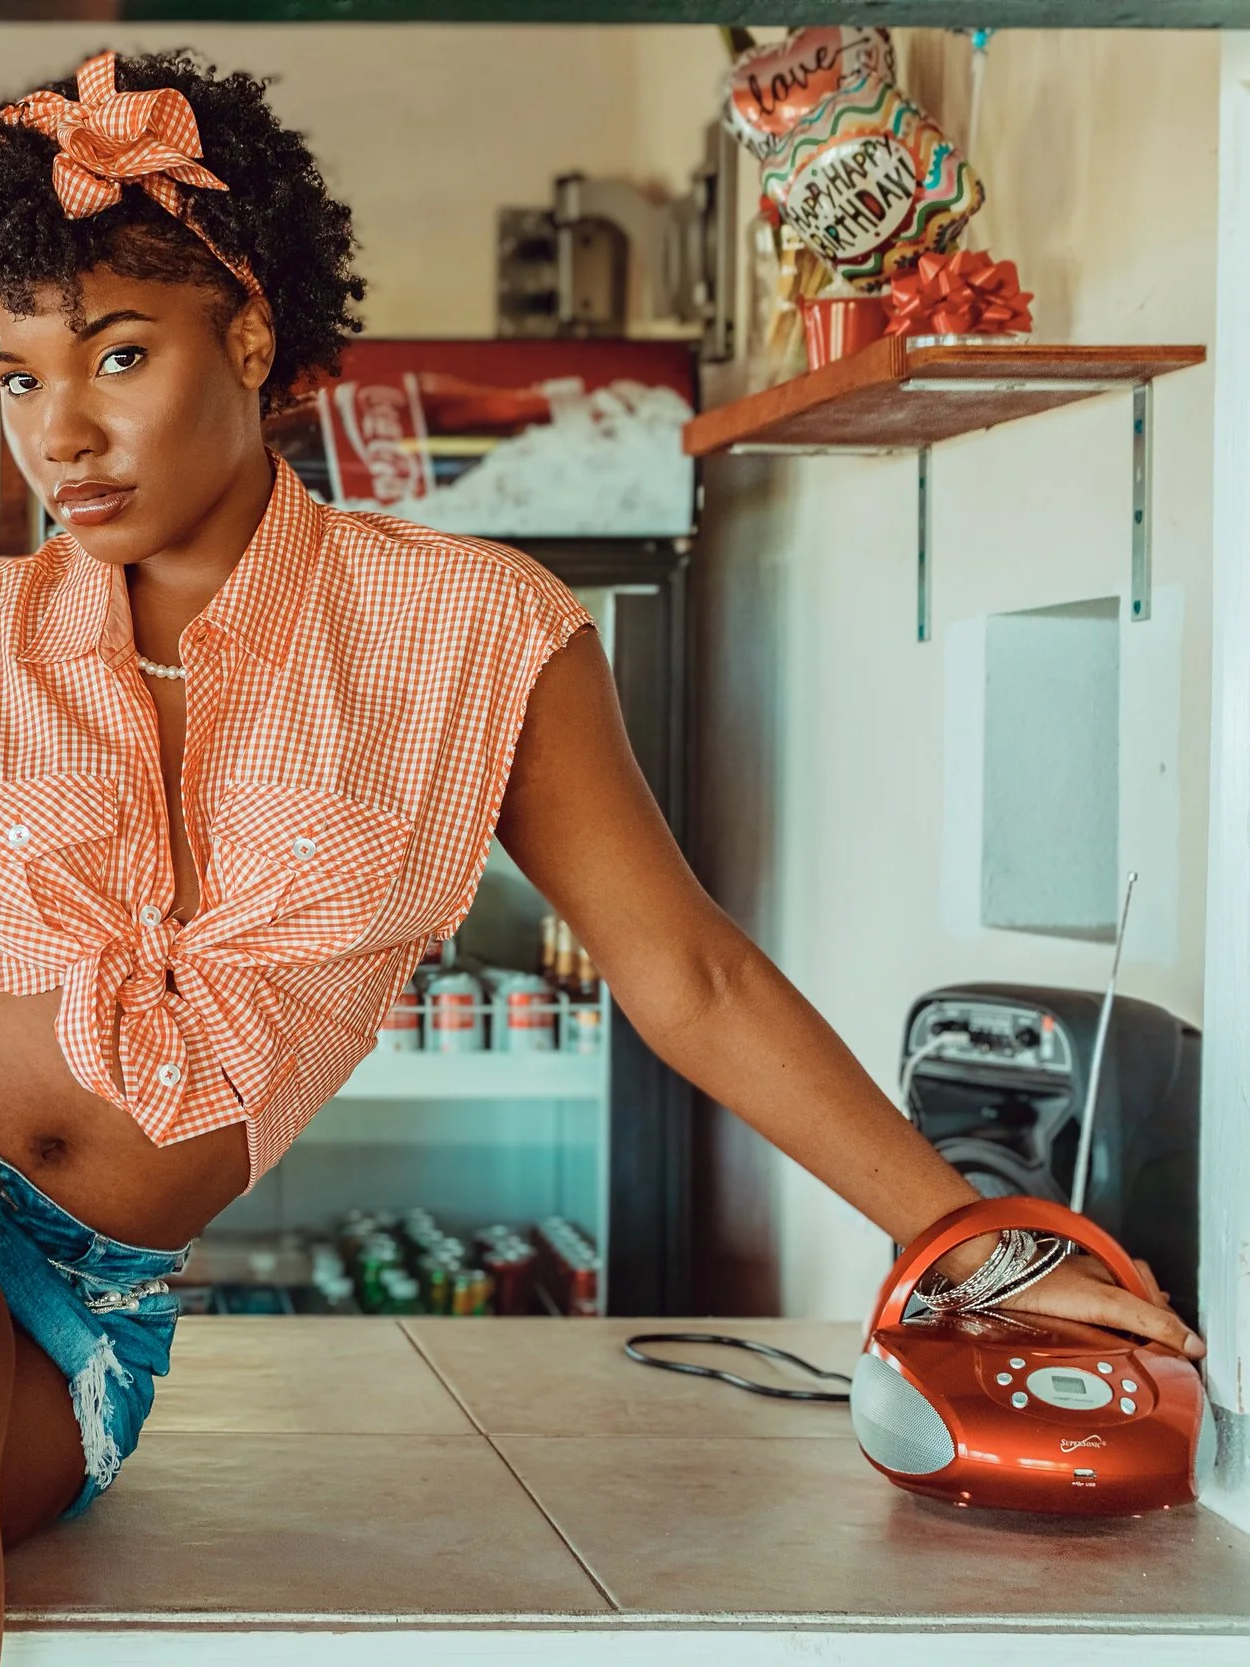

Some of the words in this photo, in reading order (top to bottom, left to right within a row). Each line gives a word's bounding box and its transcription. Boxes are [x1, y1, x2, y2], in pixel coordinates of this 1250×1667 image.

[748, 46, 842, 116] love
[790, 183, 836, 233] HAPPY
[821, 134, 892, 195] HAPPY
